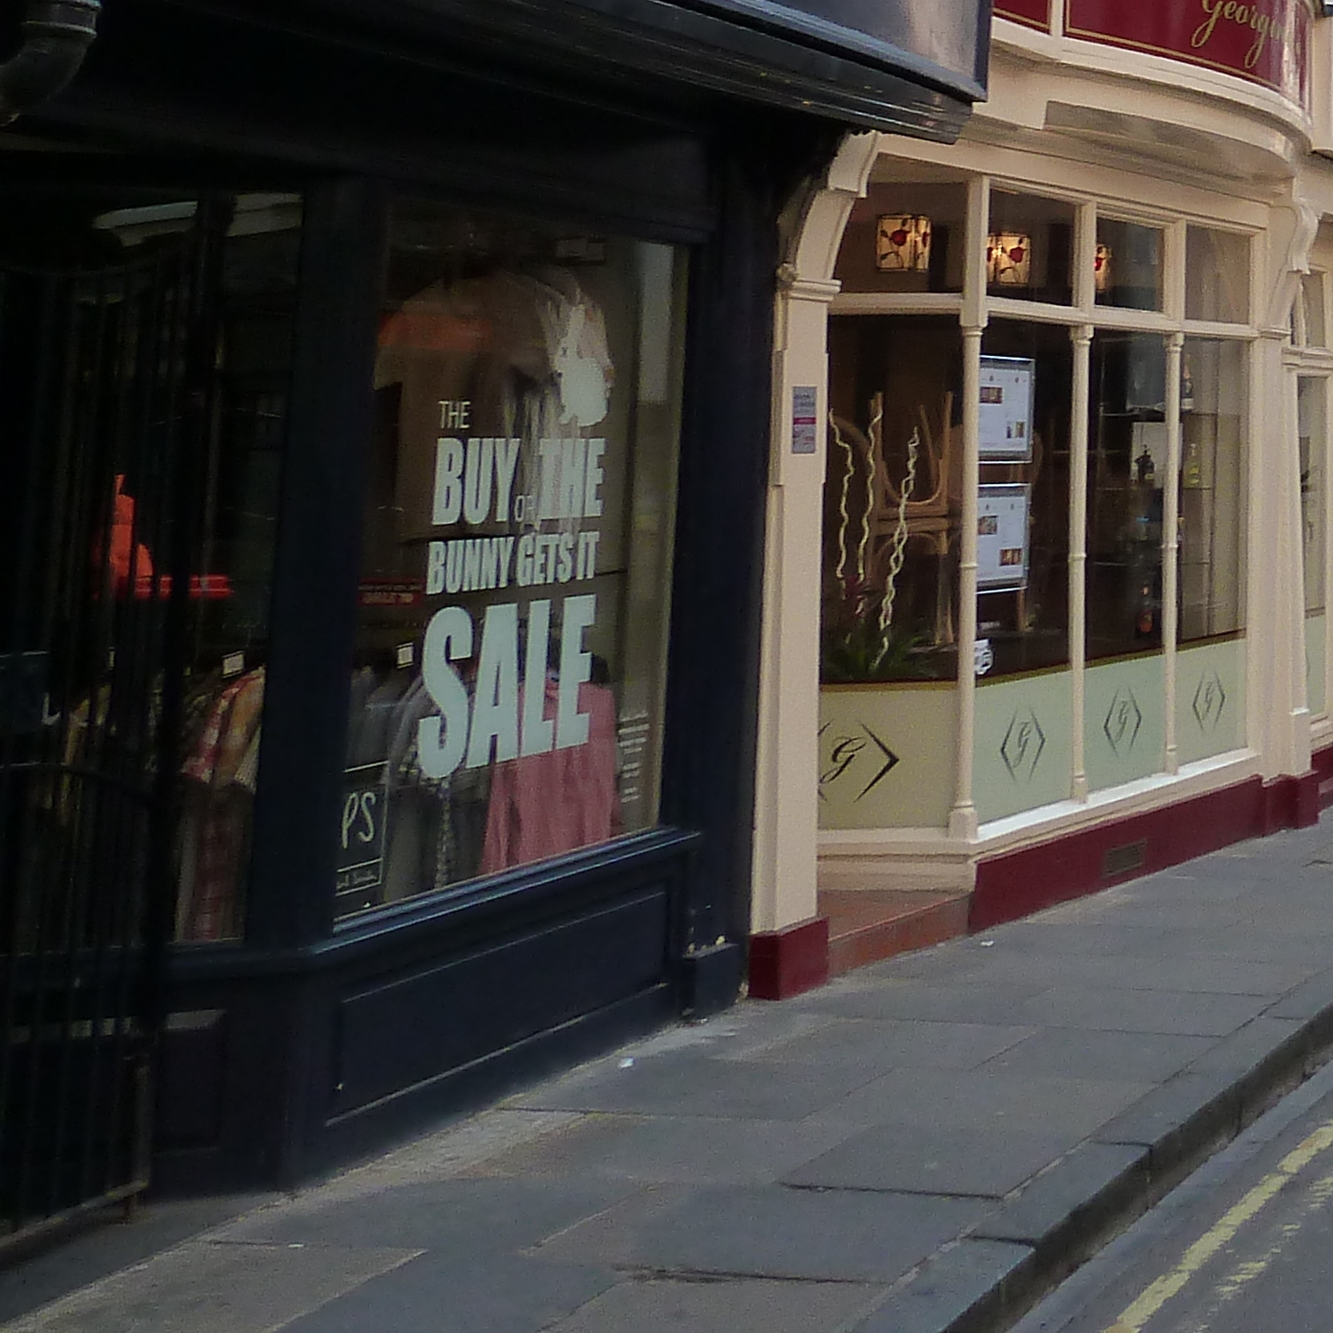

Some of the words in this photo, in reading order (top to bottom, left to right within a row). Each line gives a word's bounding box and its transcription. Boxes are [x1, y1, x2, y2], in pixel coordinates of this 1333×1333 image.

[438, 401, 471, 429] THE
[432, 437, 520, 525] BUY
[539, 437, 605, 519] THE
[426, 536, 514, 595] BUNNY
[516, 532, 573, 587] GETS
[576, 531, 599, 580] IT
[417, 594, 597, 778] SALE
[342, 791, 376, 849] PS
